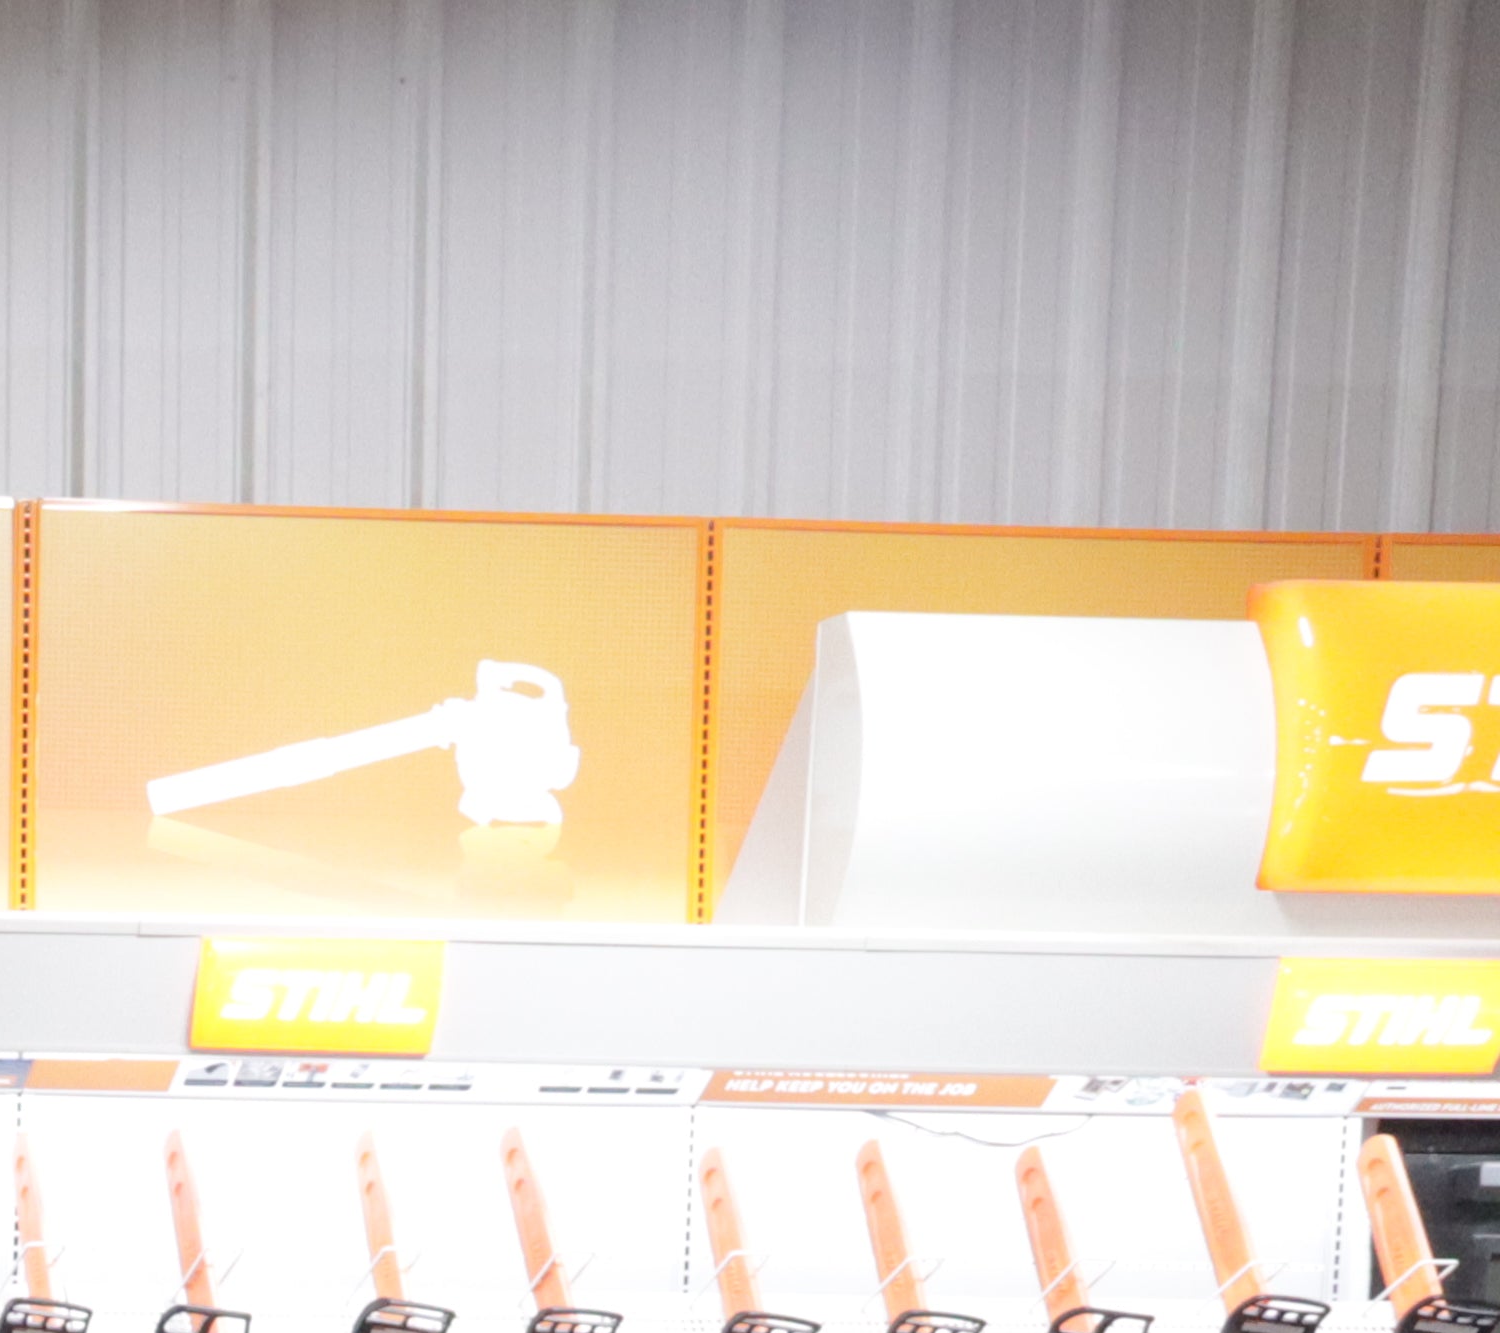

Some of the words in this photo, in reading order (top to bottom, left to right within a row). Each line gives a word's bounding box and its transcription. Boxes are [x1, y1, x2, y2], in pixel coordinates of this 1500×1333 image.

[221, 969, 426, 1023] STIHL
[1293, 995, 1492, 1046] STIHL
[725, 1079, 773, 1092] HELP
[776, 1080, 825, 1094] KEEP
[828, 1081, 865, 1095] YOU
[867, 1082, 898, 1095] ON
[900, 1082, 937, 1096] THE
[938, 1082, 978, 1096] JOB
